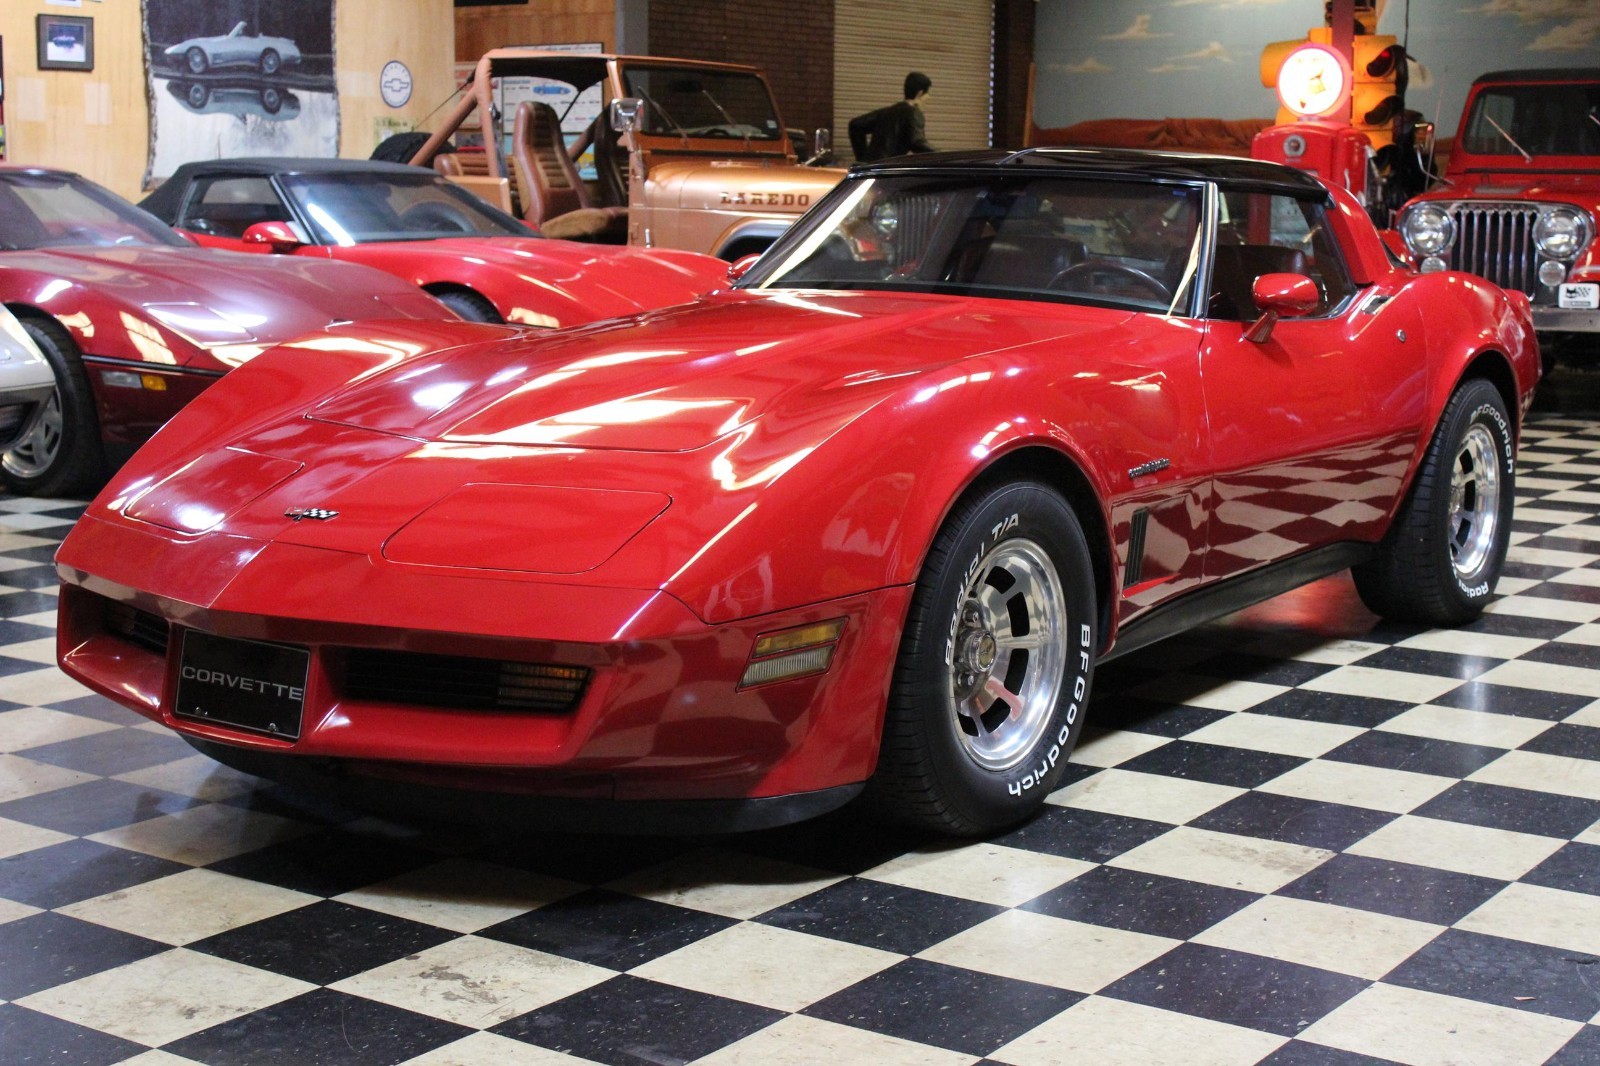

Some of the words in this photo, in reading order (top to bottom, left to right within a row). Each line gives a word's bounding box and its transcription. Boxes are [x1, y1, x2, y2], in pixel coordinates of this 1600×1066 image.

[720, 191, 810, 206] LAREDO
[944, 541, 985, 666] Radial
[991, 512, 1019, 542] T/A
[181, 665, 304, 701] CORVETTE
[1008, 623, 1091, 797] BFGoodrich
